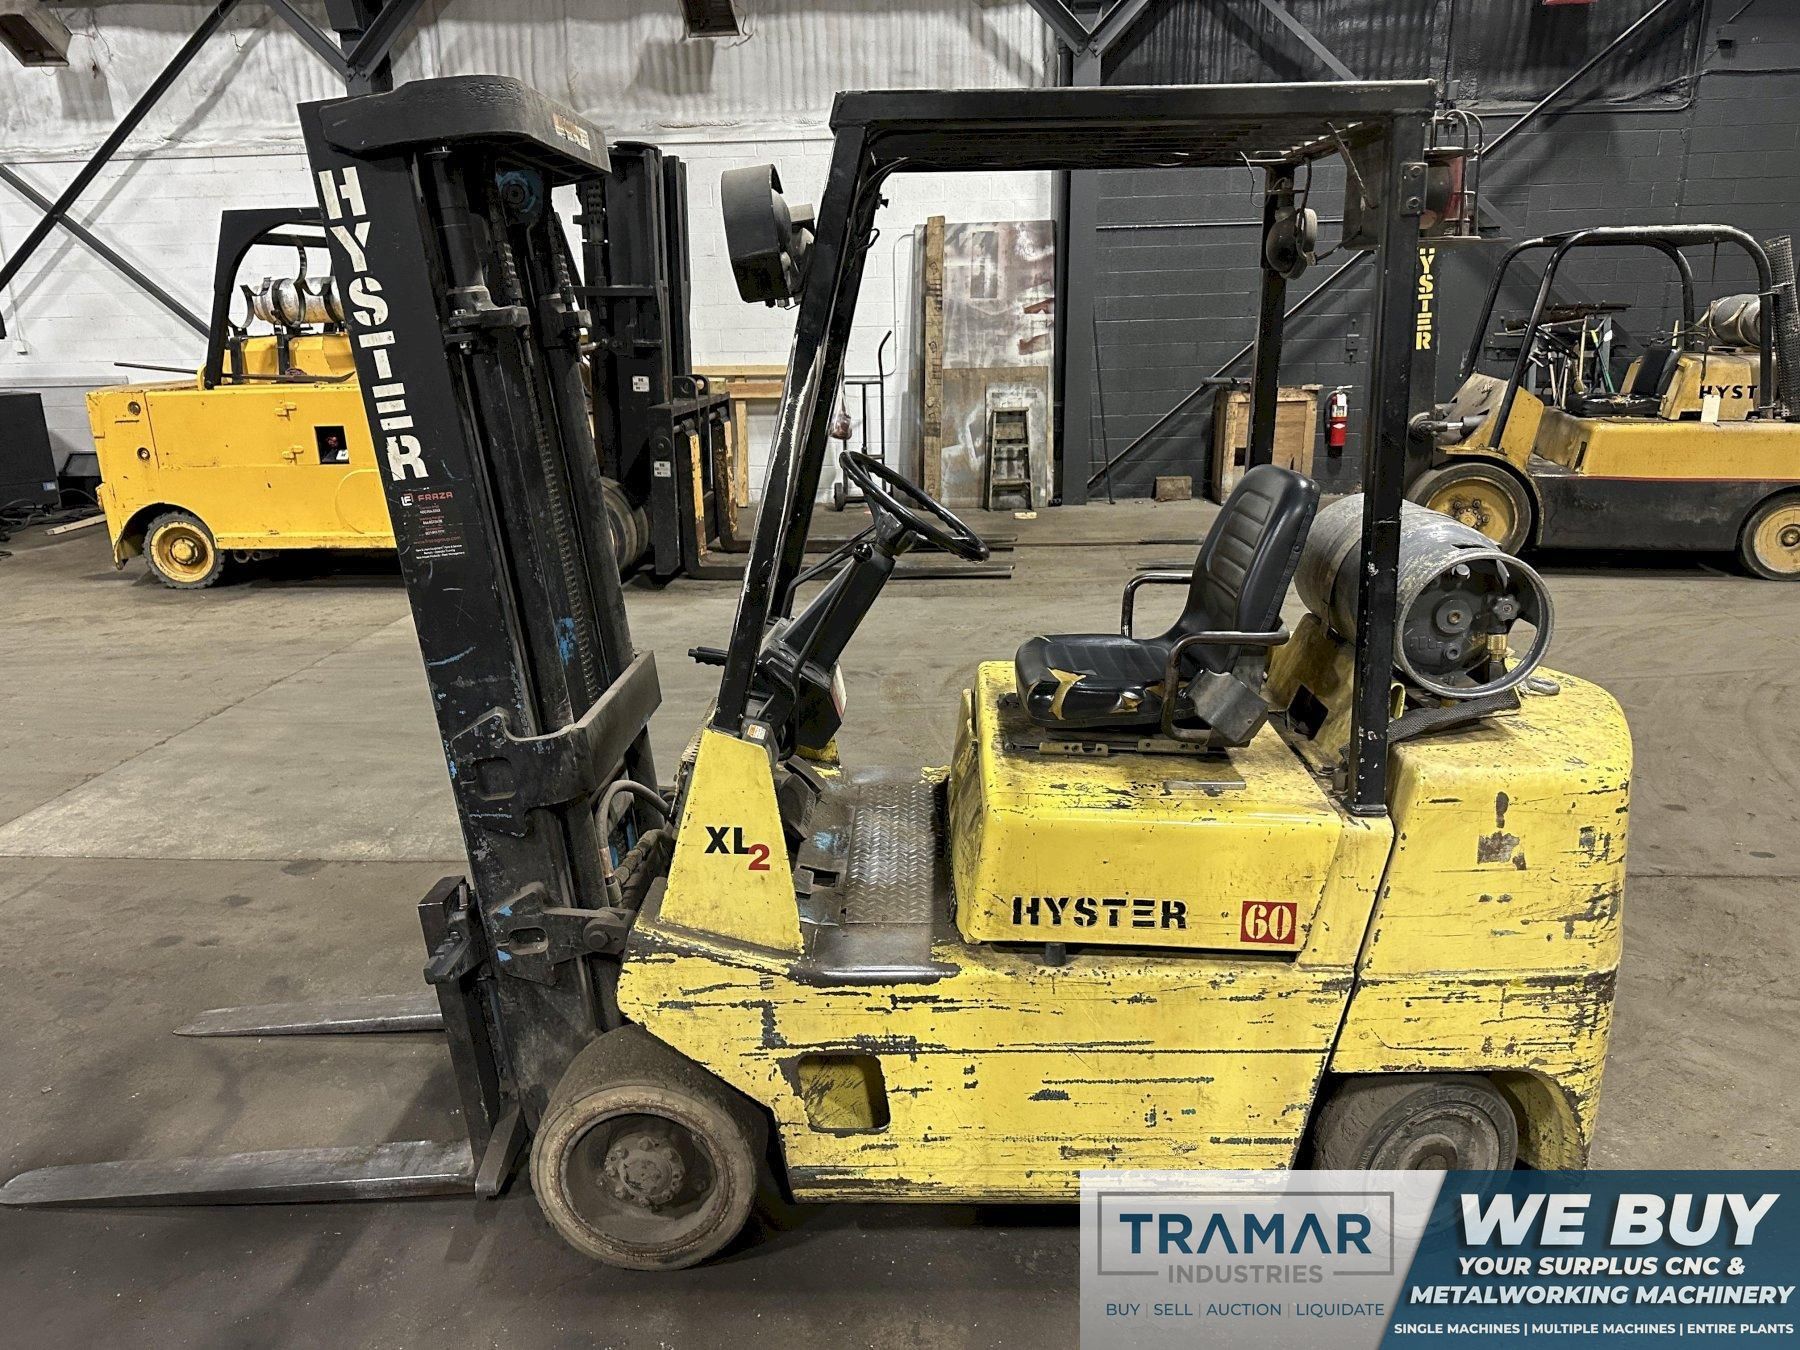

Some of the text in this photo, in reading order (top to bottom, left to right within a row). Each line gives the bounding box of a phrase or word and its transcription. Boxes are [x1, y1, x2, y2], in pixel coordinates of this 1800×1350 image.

[318, 166, 429, 482] HYSTER
[1699, 385, 1758, 400] HYST
[418, 491, 454, 502] FRAZA
[1012, 896, 1188, 930] HYSTER
[1245, 903, 1293, 941] 60
